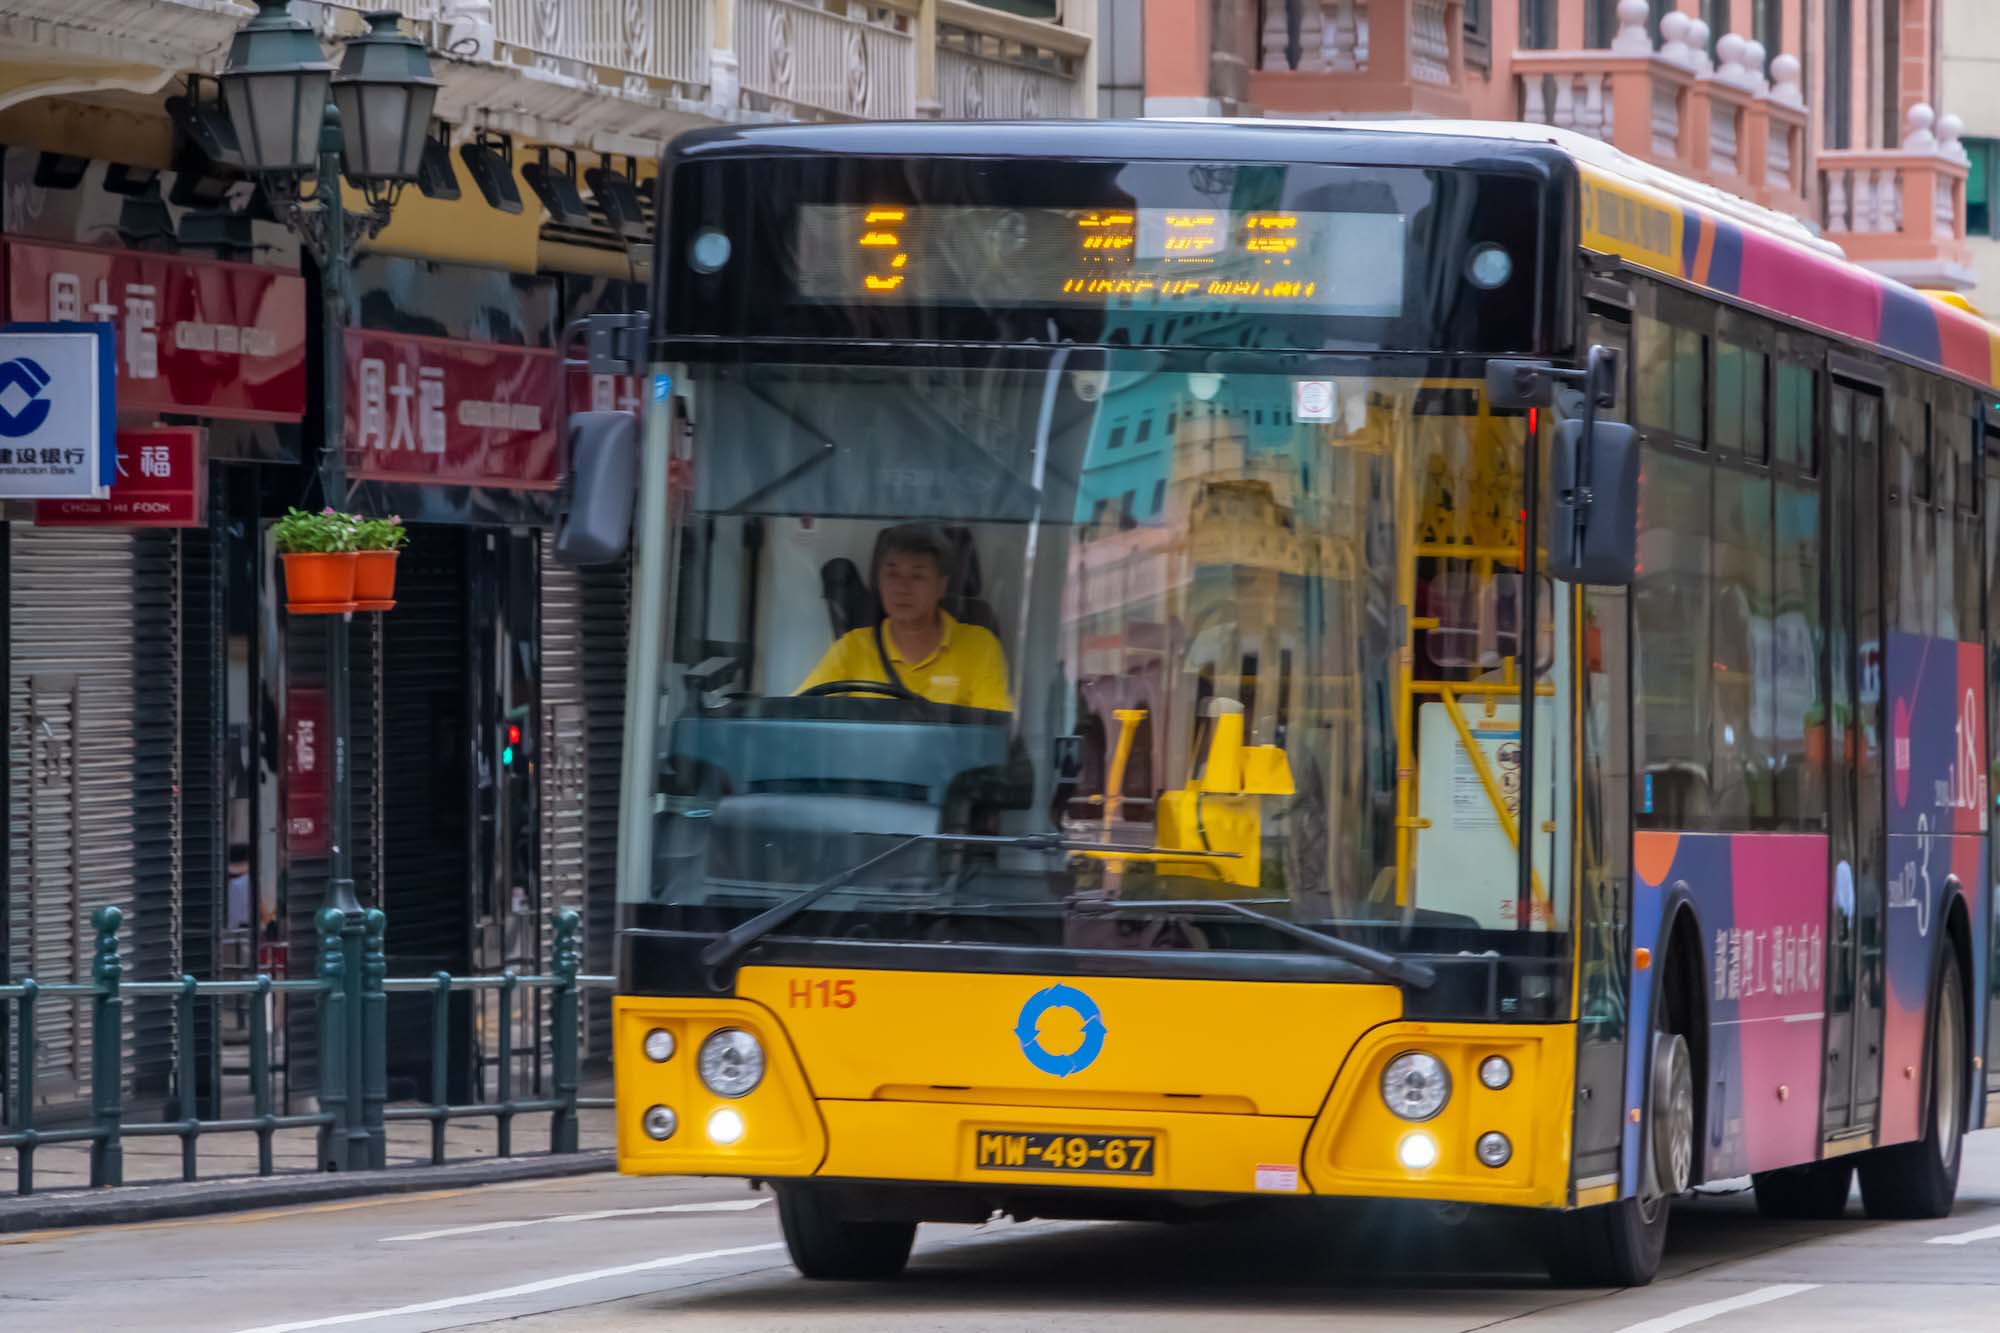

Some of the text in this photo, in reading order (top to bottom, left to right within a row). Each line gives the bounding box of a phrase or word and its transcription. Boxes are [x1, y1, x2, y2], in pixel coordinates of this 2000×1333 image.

[132, 502, 172, 512] FOOK
[788, 979, 857, 1009] H15
[979, 1134, 1151, 1171] MW-49-67
